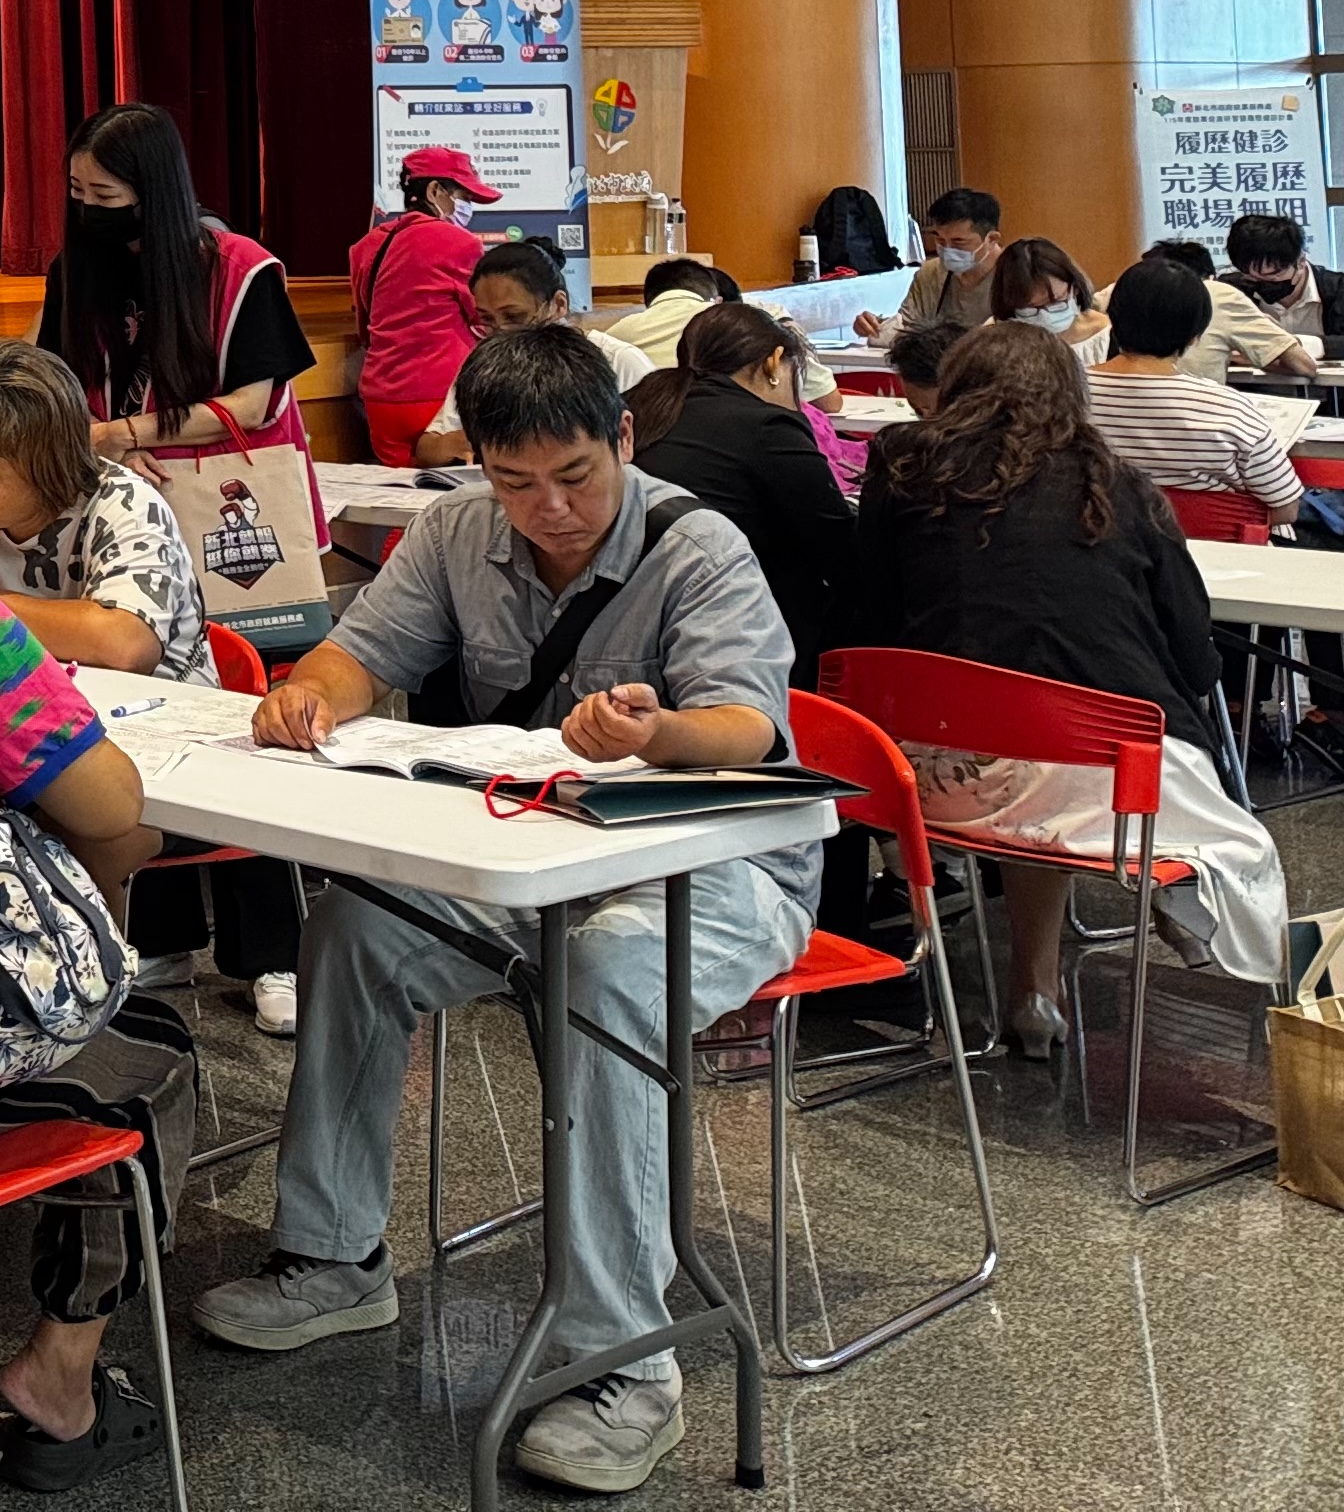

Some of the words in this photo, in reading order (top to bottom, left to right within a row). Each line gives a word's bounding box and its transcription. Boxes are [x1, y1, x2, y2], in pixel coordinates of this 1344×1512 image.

[1175, 129, 1289, 155] 履歷健診
[1160, 161, 1307, 194] 完美履歷
